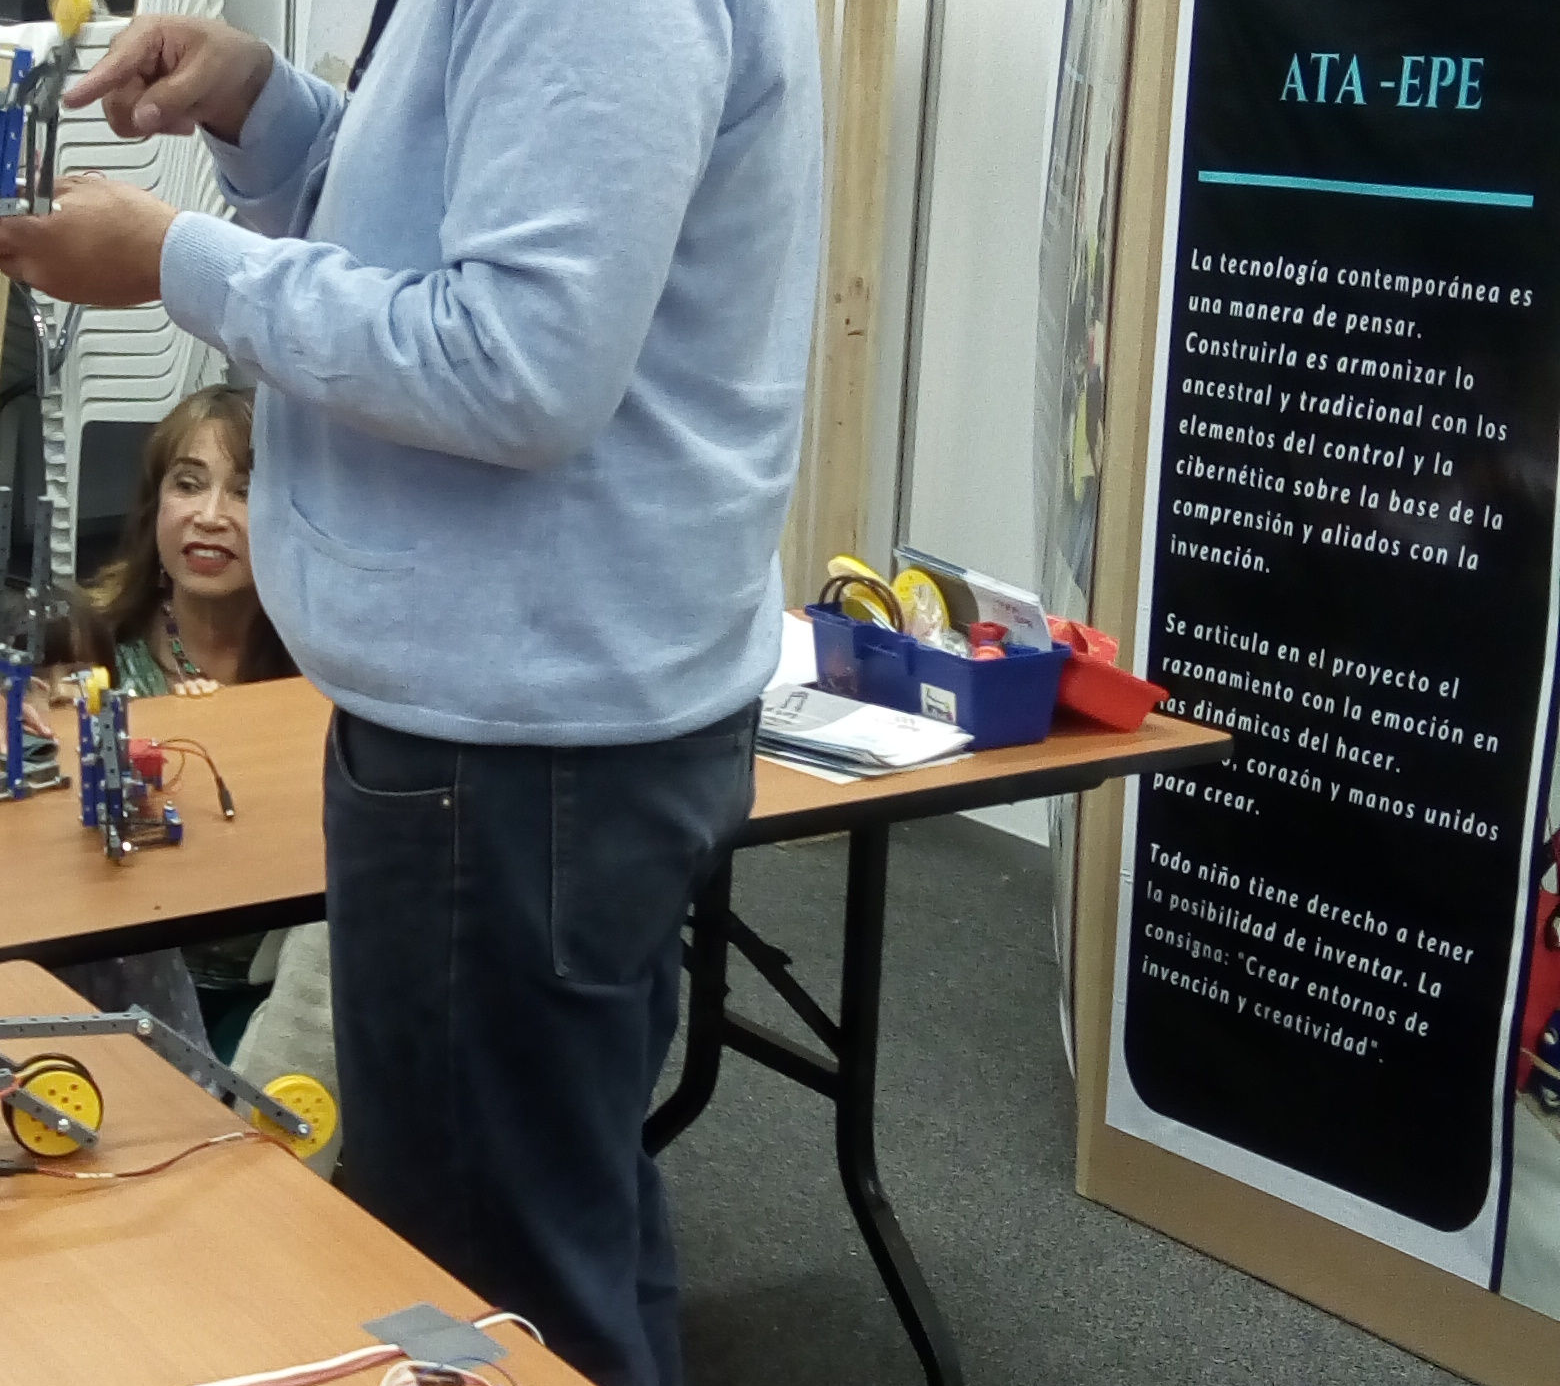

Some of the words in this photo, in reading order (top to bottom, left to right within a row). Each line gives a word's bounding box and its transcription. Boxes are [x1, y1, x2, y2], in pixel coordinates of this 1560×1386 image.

[1280, 51, 1367, 106] ATA
[1191, 248, 1212, 272] La
[1220, 253, 1328, 286] tecnología
[1337, 266, 1500, 304] contemporánea
[1509, 285, 1533, 307] es
[1188, 294, 1222, 315] una
[1230, 298, 1303, 325] manera
[1313, 304, 1337, 328] de
[1345, 311, 1423, 340] pensar.
[1185, 332, 1297, 367] Construirla
[1306, 349, 1328, 371] es
[1337, 354, 1446, 388] armonizar
[1455, 366, 1474, 391] lo
[1179, 415, 1276, 449] elementos
[1283, 430, 1315, 456] del
[1323, 440, 1404, 470] control
[1413, 452, 1424, 475] y
[1434, 452, 1454, 477] la
[1182, 377, 1272, 406] ancestral
[1280, 391, 1290, 413] y
[1300, 390, 1423, 428] tradicional
[1431, 412, 1468, 435] con
[1477, 414, 1508, 441] los
[1176, 454, 1285, 493] cibernética
[1293, 475, 1351, 505] sobre
[1359, 485, 1379, 508] la
[1389, 489, 1440, 519] base
[1449, 500, 1475, 525] de
[1483, 506, 1503, 531] la
[1170, 534, 1271, 574] invención.
[1172, 498, 1294, 537] comprensión
[1302, 523, 1313, 545] y
[1321, 523, 1401, 557] aliados
[1410, 541, 1448, 566] con
[1458, 545, 1479, 571] la
[1165, 612, 1187, 635] Se
[1194, 622, 1270, 656] articula
[1277, 642, 1300, 663] en
[1308, 648, 1326, 670] el
[1332, 655, 1430, 693] proyecto
[1439, 676, 1460, 700] el
[1162, 655, 1294, 704] razonamiento
[1301, 690, 1335, 714] con
[1344, 696, 1362, 721] la
[1371, 711, 1465, 745] emoción
[1473, 731, 1500, 753] en
[1193, 696, 1290, 743] dinámicas
[1298, 727, 1329, 754] del
[1336, 737, 1402, 773] hacer.
[1153, 772, 1196, 797] para
[1204, 782, 1260, 816] crear.
[1246, 756, 1321, 794] corazón
[1330, 779, 1341, 802] y
[1348, 786, 1416, 820] manos
[1424, 806, 1500, 842] unidos
[1147, 880, 1163, 903] la
[1169, 892, 1277, 943] posibilidad
[1283, 928, 1307, 952] de
[1314, 937, 1409, 987] inventar.
[1417, 971, 1442, 999] La
[1150, 843, 1191, 874] Todo
[1197, 864, 1240, 891] niño
[1248, 876, 1299, 908] tiene
[1307, 893, 1388, 937] derecho
[1396, 925, 1408, 944] a
[1417, 929, 1474, 965] tener
[1142, 955, 1230, 1005] invención
[1238, 993, 1248, 1014] y
[1254, 1001, 1384, 1063] creatividad".
[1144, 921, 1229, 966] consigna:
[1237, 951, 1300, 991] "Crear
[1307, 981, 1397, 1025] entornos
[1404, 1011, 1430, 1037] de
